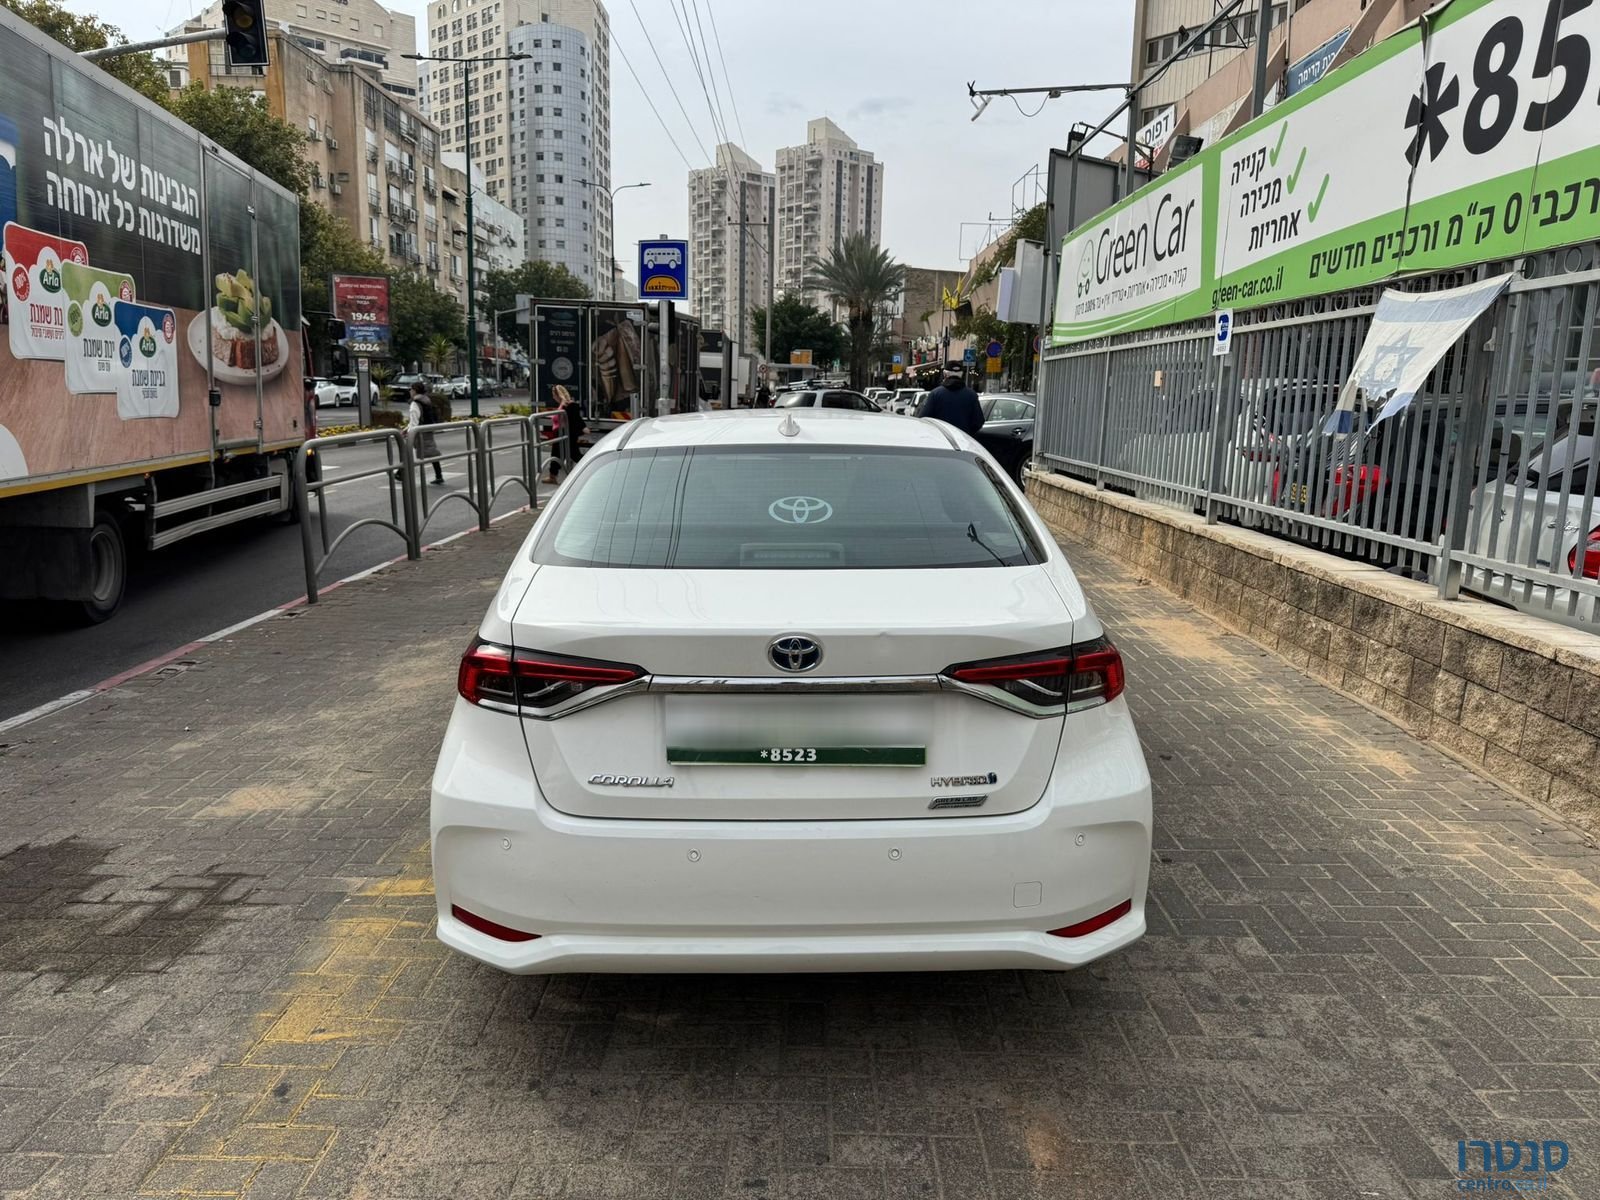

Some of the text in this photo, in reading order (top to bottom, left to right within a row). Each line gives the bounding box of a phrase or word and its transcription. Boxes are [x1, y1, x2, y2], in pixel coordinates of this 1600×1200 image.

[1297, 61, 1320, 86] קדימה
[1404, 0, 1600, 169] 85
[1144, 114, 1170, 146] דפוס
[43, 116, 200, 219] הגבינות של ארלה
[1231, 146, 1267, 186] קנייה
[1240, 177, 1282, 218] מכירה
[46, 170, 202, 256] משדרגות כל ארוחה
[1096, 193, 1195, 285] Green Car
[1248, 209, 1302, 252] אחריות
[1371, 220, 1441, 265] ורכבים
[1309, 241, 1368, 279] חדשים
[42, 270, 60, 288] Arla
[1211, 265, 1284, 309] green-car.co.il
[29, 303, 53, 326] שמנת
[94, 304, 110, 321] Arla
[351, 312, 377, 321] 1945
[83, 338, 103, 358] שמנת
[141, 339, 156, 353] Arla
[353, 343, 380, 352] 2024
[131, 369, 166, 387] גבינת שמנת
[587, 774, 676, 789] COROLLA
[930, 774, 988, 787] HYBRID
